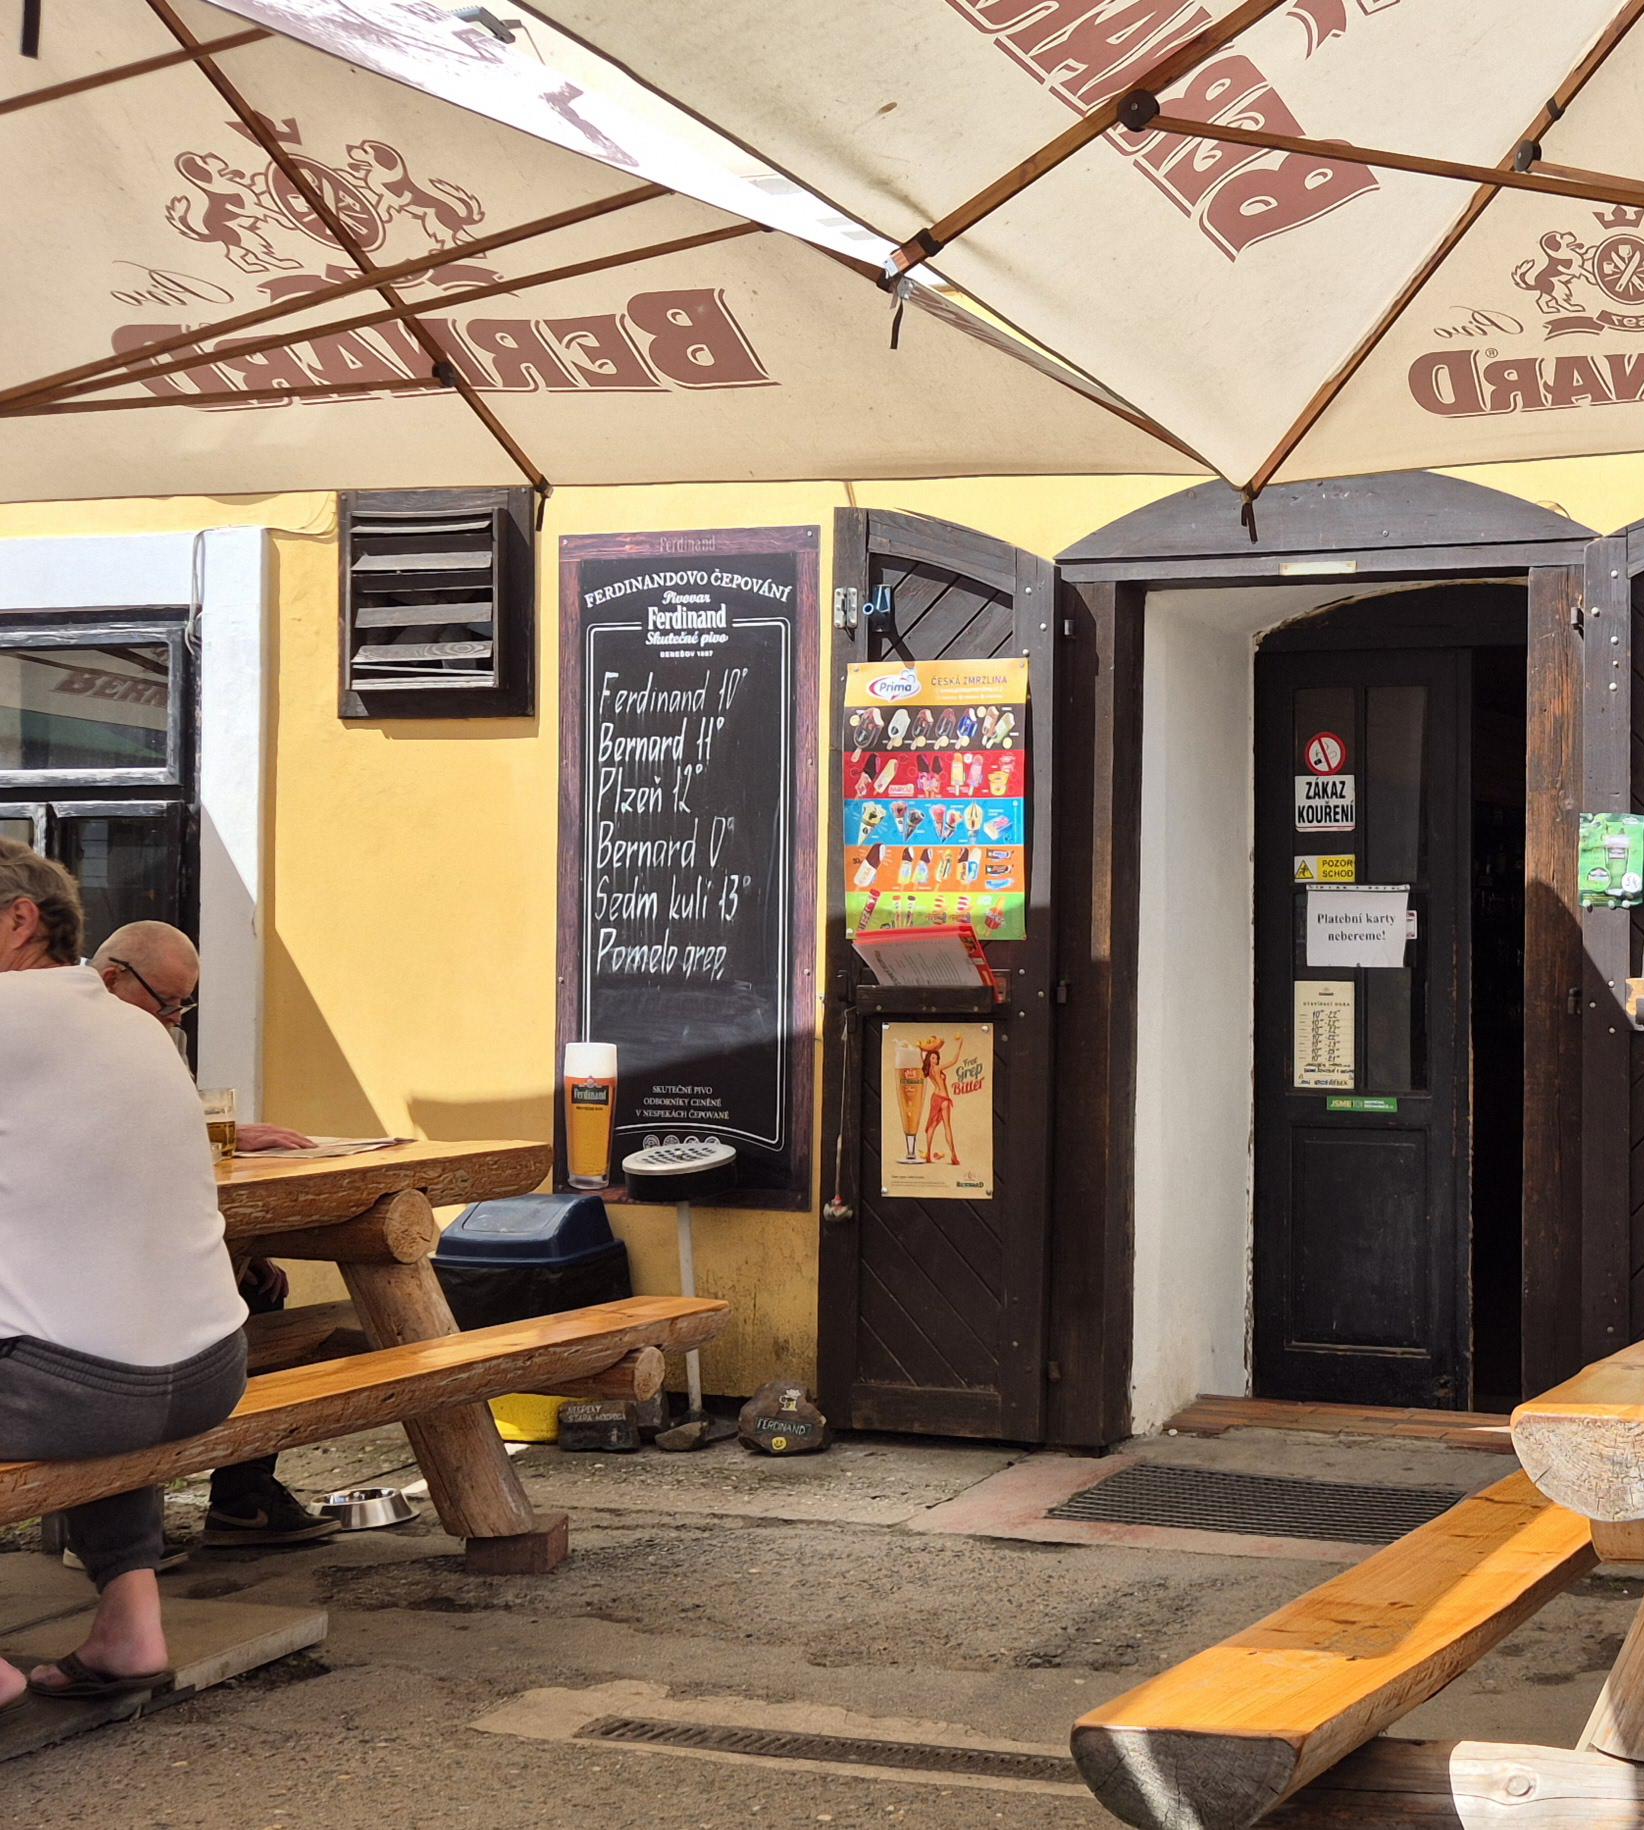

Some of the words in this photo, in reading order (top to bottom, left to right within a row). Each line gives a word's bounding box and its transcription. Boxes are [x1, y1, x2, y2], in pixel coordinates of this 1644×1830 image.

[584, 569, 709, 609] FERDINANDOVO
[710, 567, 793, 603] ČEPOVÁNÍ
[648, 603, 728, 630] Ferdinand
[701, 630, 729, 649] pivo
[599, 669, 711, 715] Ferdinand
[879, 681, 913, 694] Prima
[598, 716, 688, 763] Bernard
[597, 766, 664, 814] Plzeň
[1305, 776, 1347, 799] ZÁKAZ
[1297, 800, 1356, 824] KOUŘENÍ
[597, 817, 699, 870] Bernard
[1322, 859, 1354, 868] POZOR
[1322, 869, 1354, 879] SCHOD
[595, 875, 658, 921] Sedm
[1316, 912, 1364, 924] Platební
[1366, 912, 1396, 926] karty
[1327, 929, 1387, 942] nebereme!
[596, 927, 679, 977] Pomelo
[693, 1086, 713, 1095] PIVO
